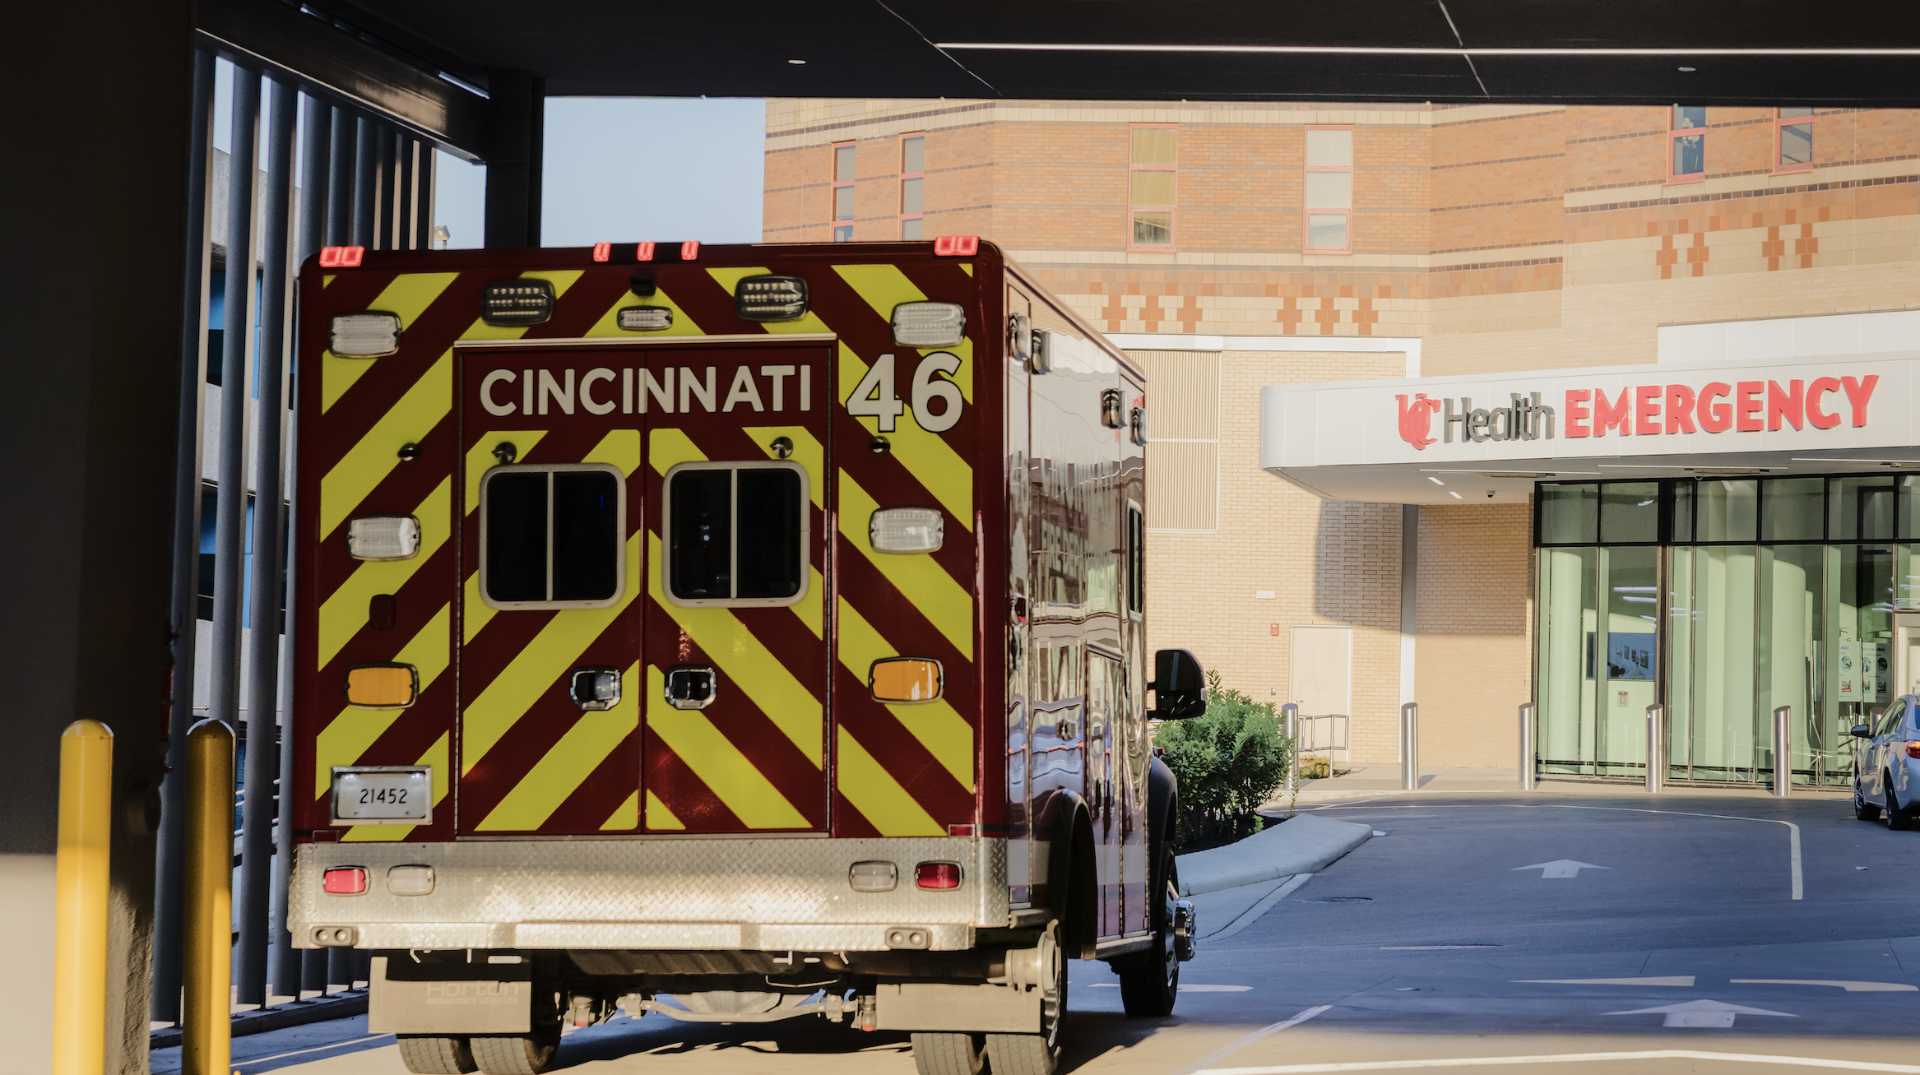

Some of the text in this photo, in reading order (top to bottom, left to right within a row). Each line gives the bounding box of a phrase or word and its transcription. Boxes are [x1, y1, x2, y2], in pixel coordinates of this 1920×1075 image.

[480, 364, 811, 417] CINCINNATI
[846, 351, 964, 434] 46
[1443, 391, 1556, 444] Health
[1565, 374, 1880, 438] EMERGENCY
[359, 788, 408, 804] 21452
[426, 981, 519, 997] Horton
